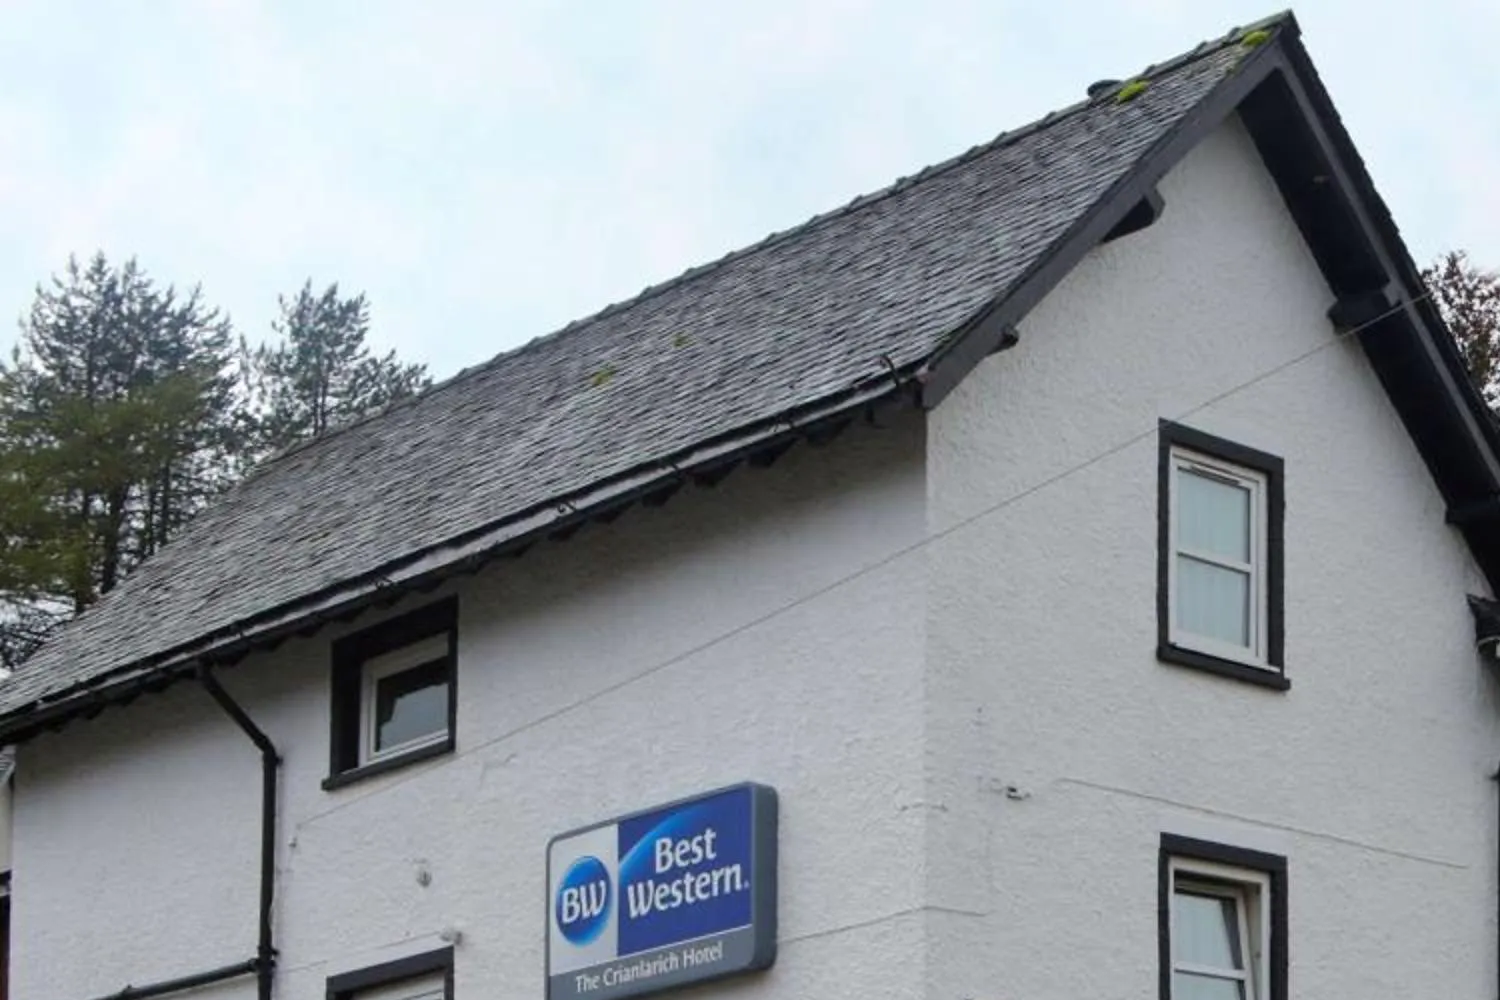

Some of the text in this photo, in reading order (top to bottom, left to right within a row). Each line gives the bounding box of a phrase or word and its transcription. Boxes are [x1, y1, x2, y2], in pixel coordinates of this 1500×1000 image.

[655, 828, 717, 874] Best
[562, 880, 606, 924] BW
[575, 941, 723, 993] The Crianlarich Hotel
